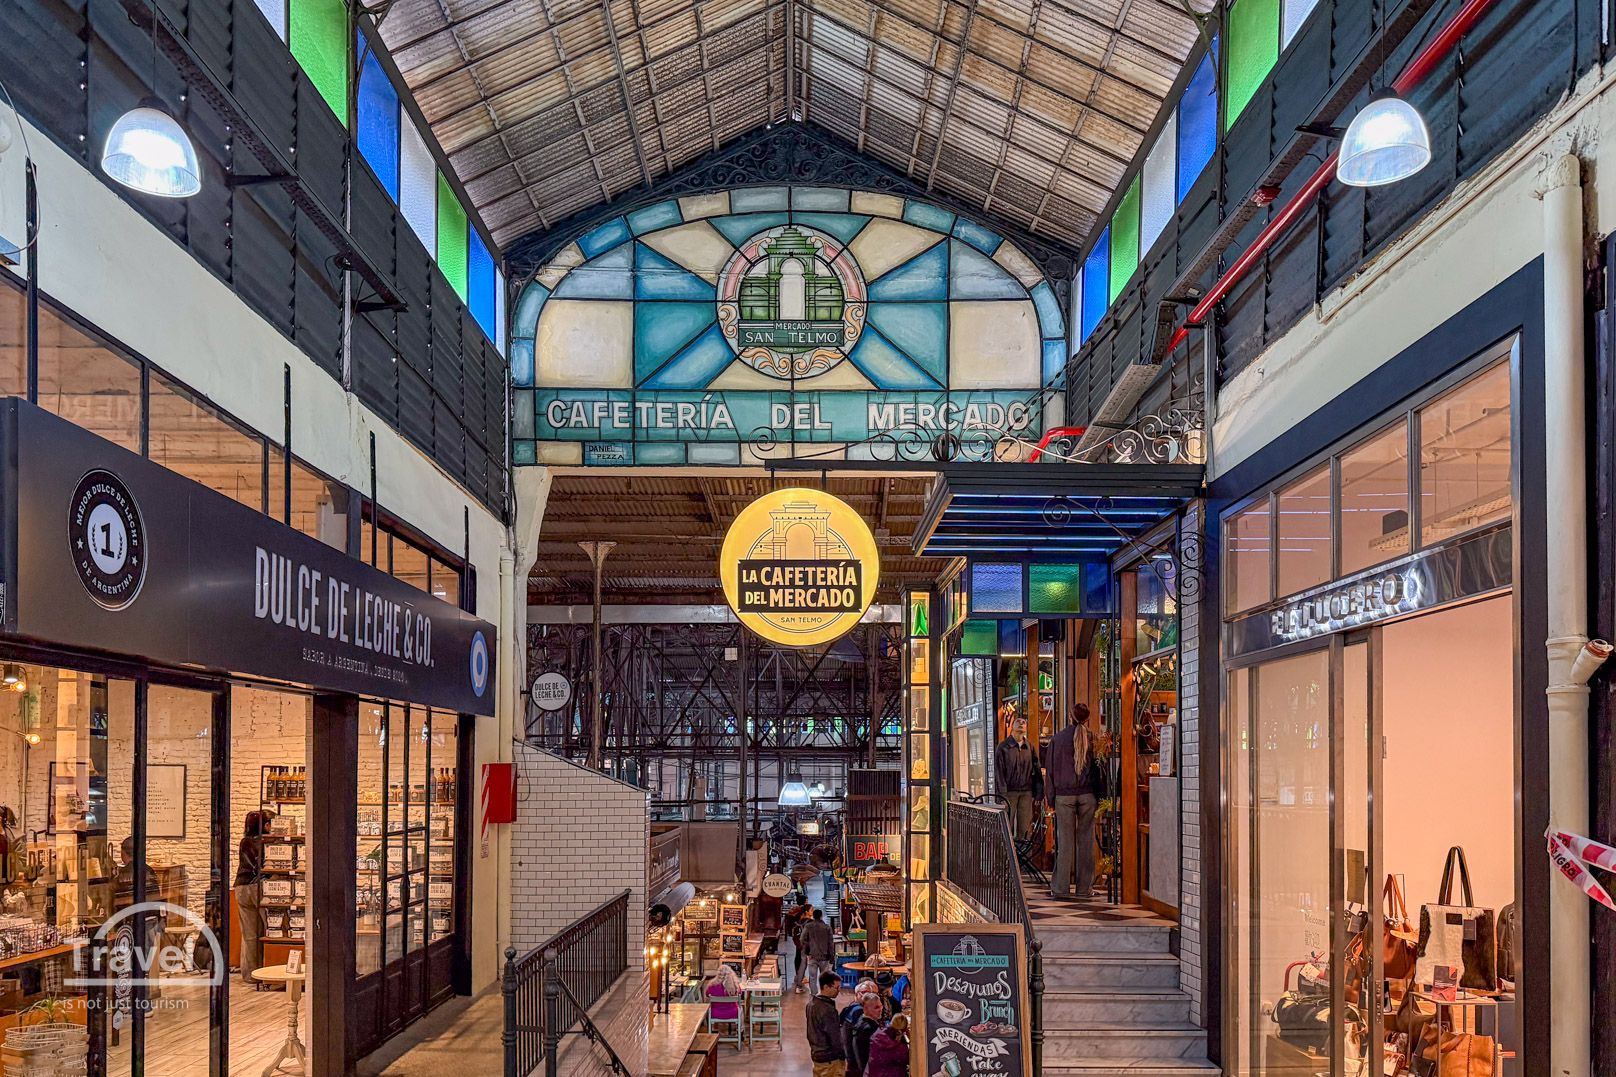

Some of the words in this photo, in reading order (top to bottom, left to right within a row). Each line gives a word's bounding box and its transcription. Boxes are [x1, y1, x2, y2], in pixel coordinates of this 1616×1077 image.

[745, 331, 774, 343] SAN
[788, 332, 837, 343] TELMO
[547, 394, 736, 429] CAFETERÍA
[771, 402, 833, 430] DEL
[868, 400, 1032, 430] MERCADO
[597, 453, 625, 461] PEZZA
[77, 490, 93, 526] MEJOR
[92, 483, 116, 497] DULCE
[115, 492, 126, 507] DE
[125, 505, 138, 547] LECHE
[101, 523, 115, 559] 1
[82, 560, 92, 577] DE
[91, 573, 133, 595] ARGENTINA
[742, 569, 758, 583] LA
[760, 562, 858, 586] CAFETERÍA
[254, 546, 322, 635] DULCE
[327, 576, 350, 643] DE
[354, 587, 401, 658] LECHE
[404, 607, 413, 660] &
[415, 613, 435, 668] CO.
[745, 591, 767, 605] DEL
[769, 588, 855, 608] MERCADO
[1300, 573, 1405, 628] LUCERO
[302, 648, 325, 665] SABOR
[535, 682, 551, 690] DULCE
[552, 682, 559, 690] DE
[535, 690, 552, 698] LECHE
[974, 957, 1006, 965] MERCADO
[978, 998, 1014, 1025] Brunch
[939, 1029, 994, 1056] MERIENDAS
[966, 1055, 1004, 1071] Take
